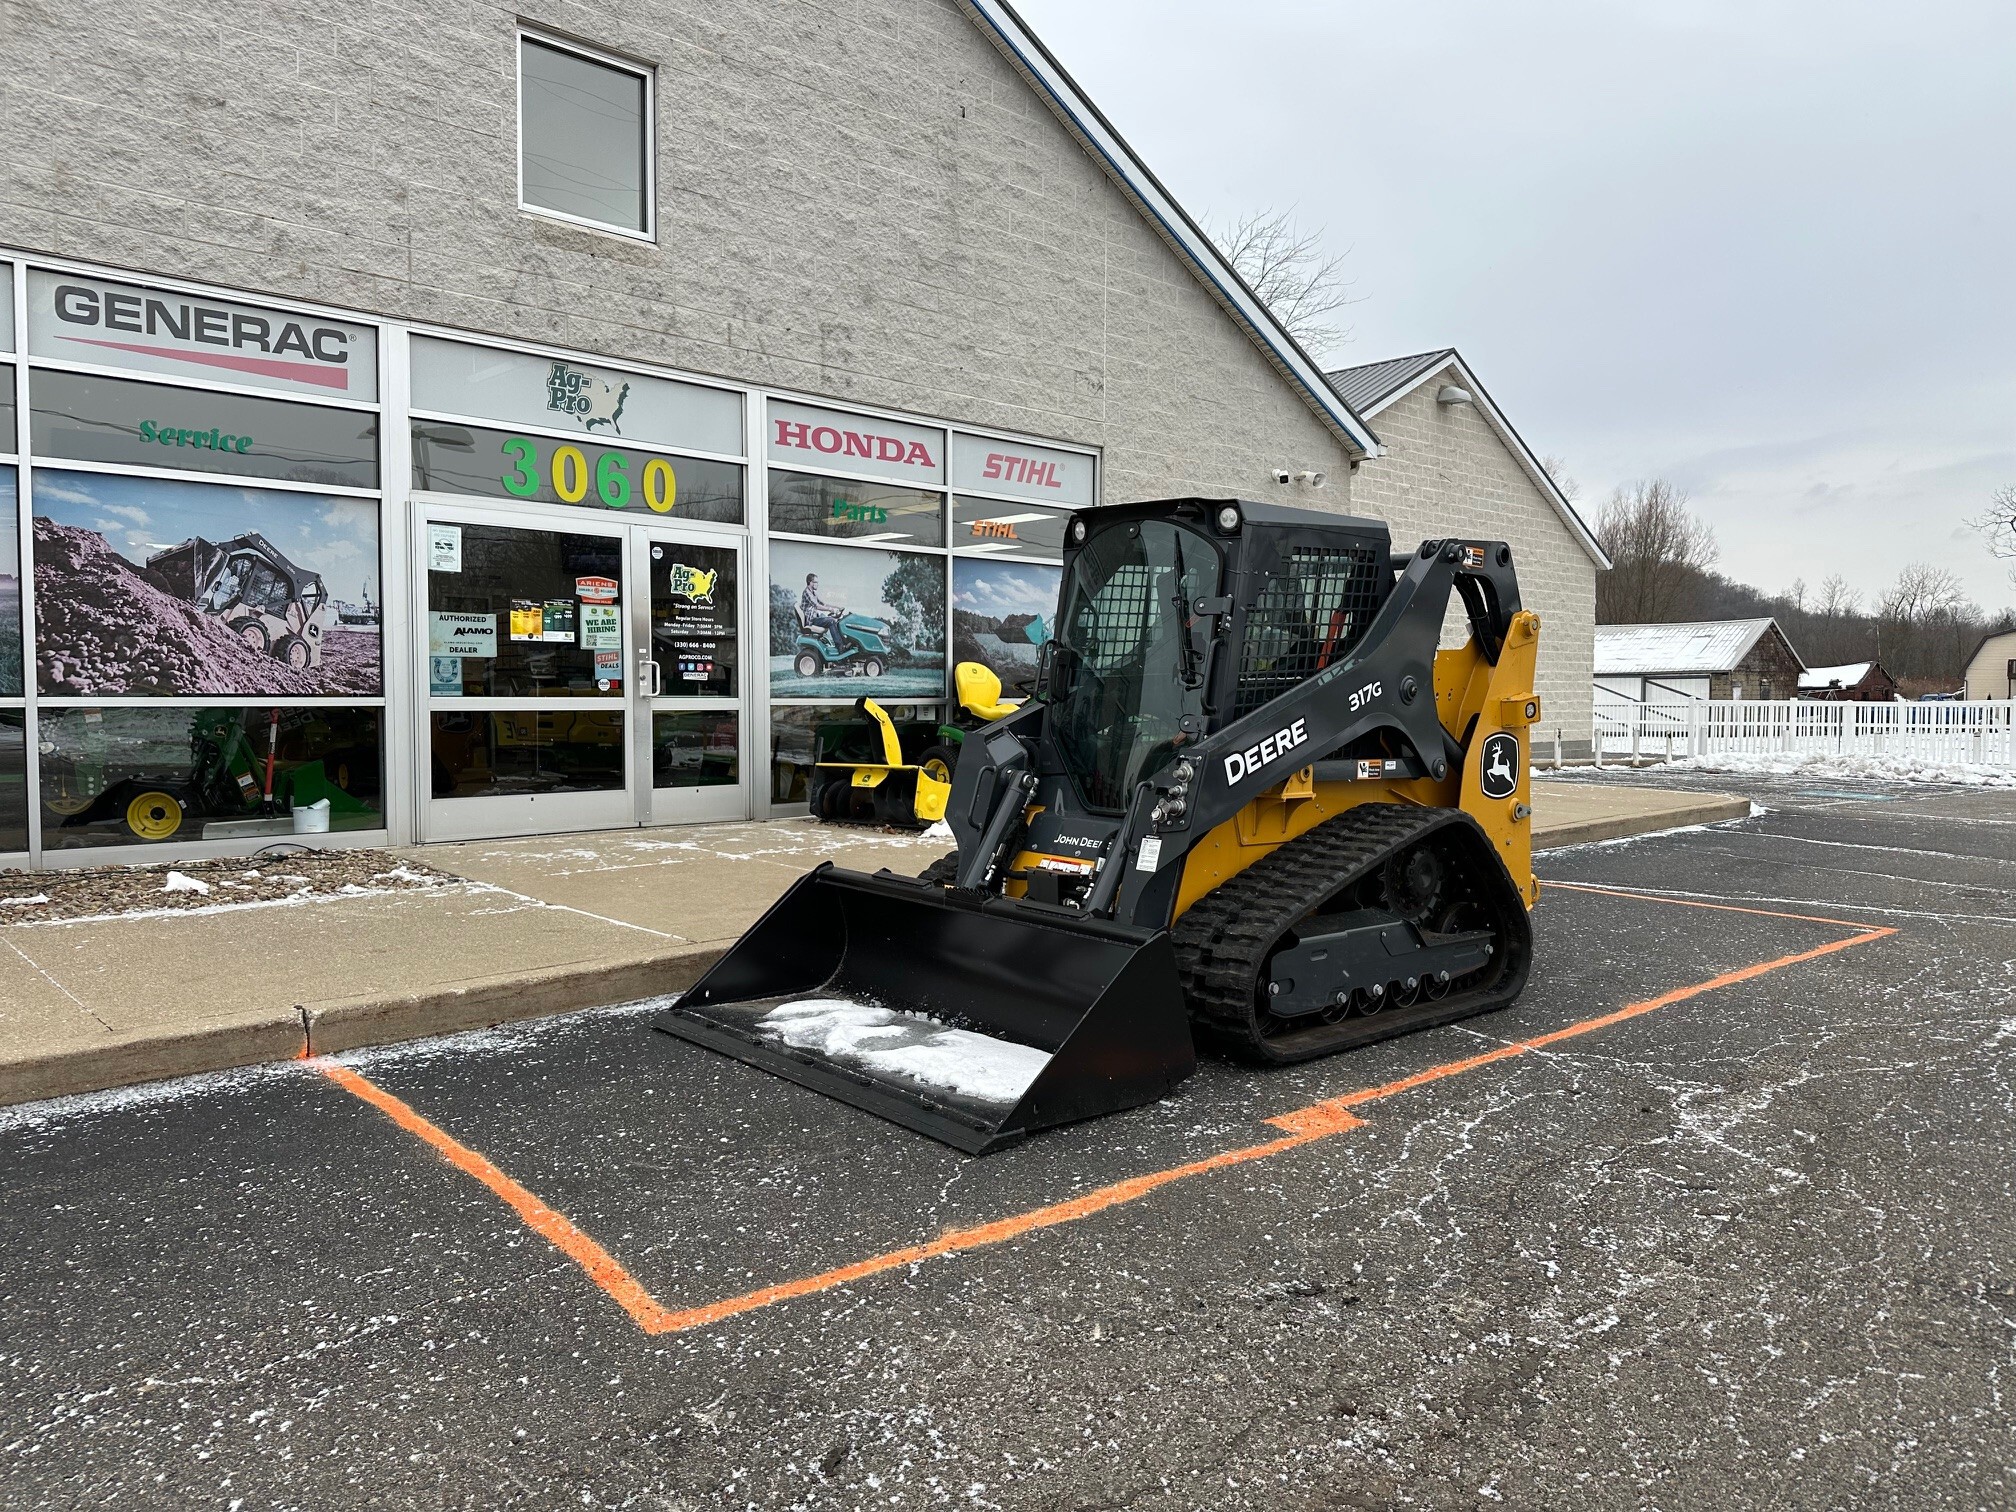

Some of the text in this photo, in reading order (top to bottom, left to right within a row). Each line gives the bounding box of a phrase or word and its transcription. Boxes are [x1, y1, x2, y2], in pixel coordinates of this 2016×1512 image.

[54, 285, 348, 363] GENERAC
[548, 362, 592, 394] Ag-
[548, 386, 592, 415] Pro
[139, 419, 254, 454] Service
[774, 419, 936, 468] HONDA
[501, 437, 676, 513] 3060
[982, 453, 1062, 488] STIHL
[833, 498, 888, 524] Parts
[971, 519, 1018, 539] STIHL
[258, 539, 279, 559] DEERE
[580, 580, 613, 588] ARIENS
[673, 566, 694, 582] Ag-
[673, 579, 695, 592] Pro
[439, 614, 487, 623] AUTHORIZED
[453, 627, 494, 636] ALAMO
[596, 653, 618, 662] STIHL
[1348, 681, 1383, 712] 317G
[1223, 717, 1309, 787] DEERE
[1053, 833, 1079, 846] JOHN
